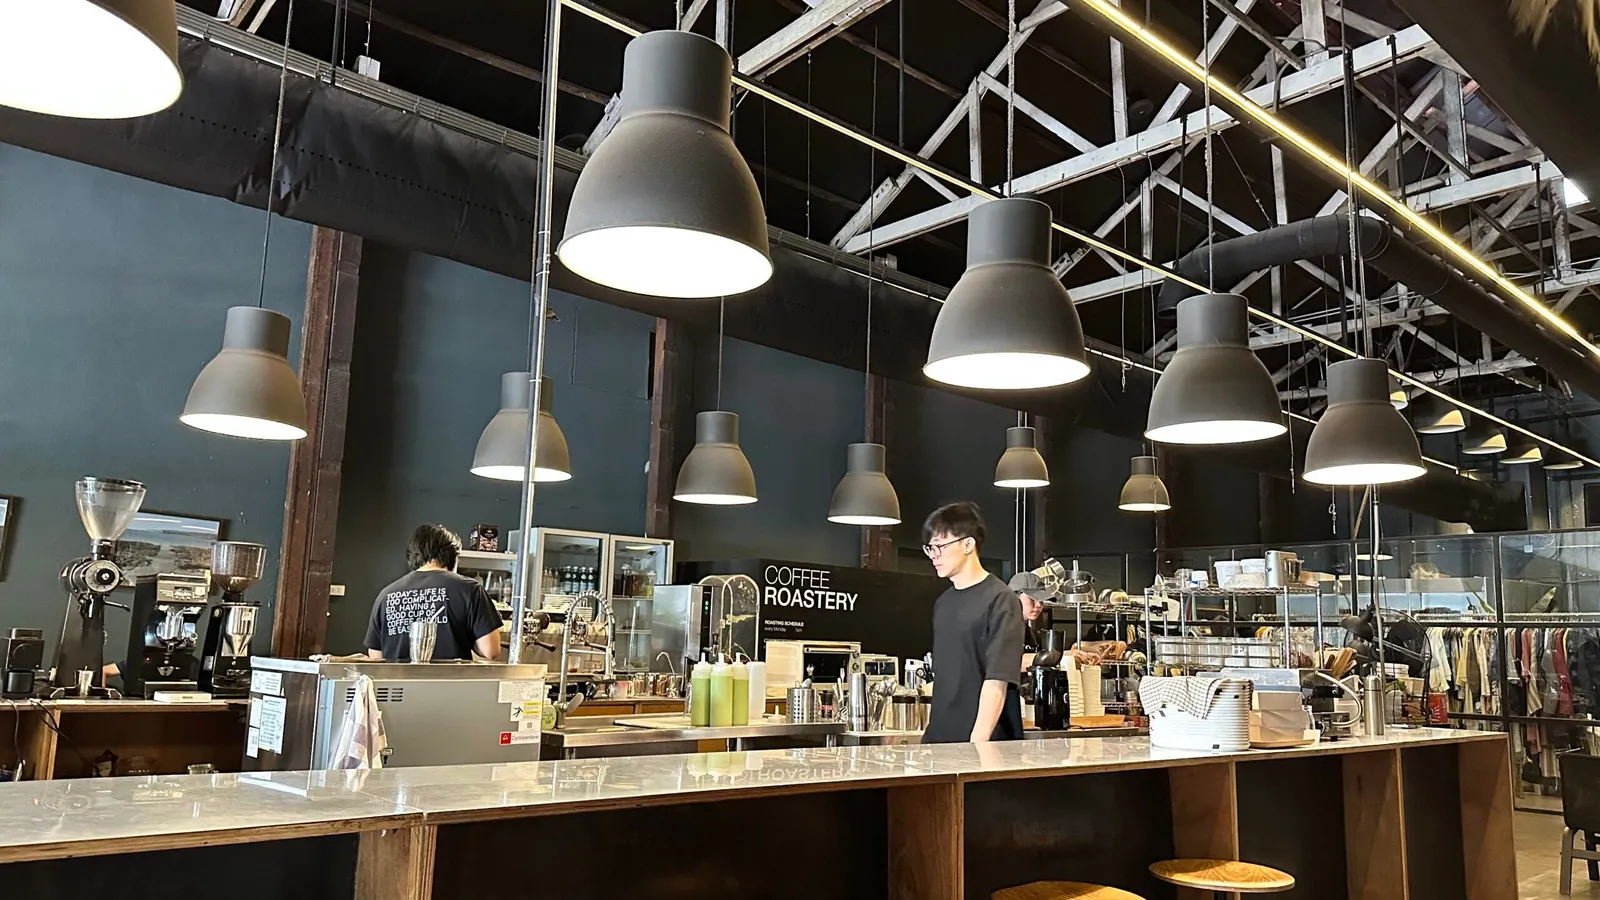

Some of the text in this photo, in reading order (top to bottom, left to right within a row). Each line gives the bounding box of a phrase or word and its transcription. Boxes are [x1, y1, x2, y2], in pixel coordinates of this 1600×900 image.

[764, 565, 831, 590] COFFEE
[387, 590, 419, 600] TODAY'S
[419, 588, 437, 596] LIFE
[402, 595, 449, 604] COMPLICAT-
[764, 586, 858, 611] ROASTERY
[386, 602, 436, 614] ED. HAVING A
[386, 609, 436, 621] GOOD CUP OF
[387, 618, 415, 629] COFFEE
[388, 626, 411, 636] BE EAS
